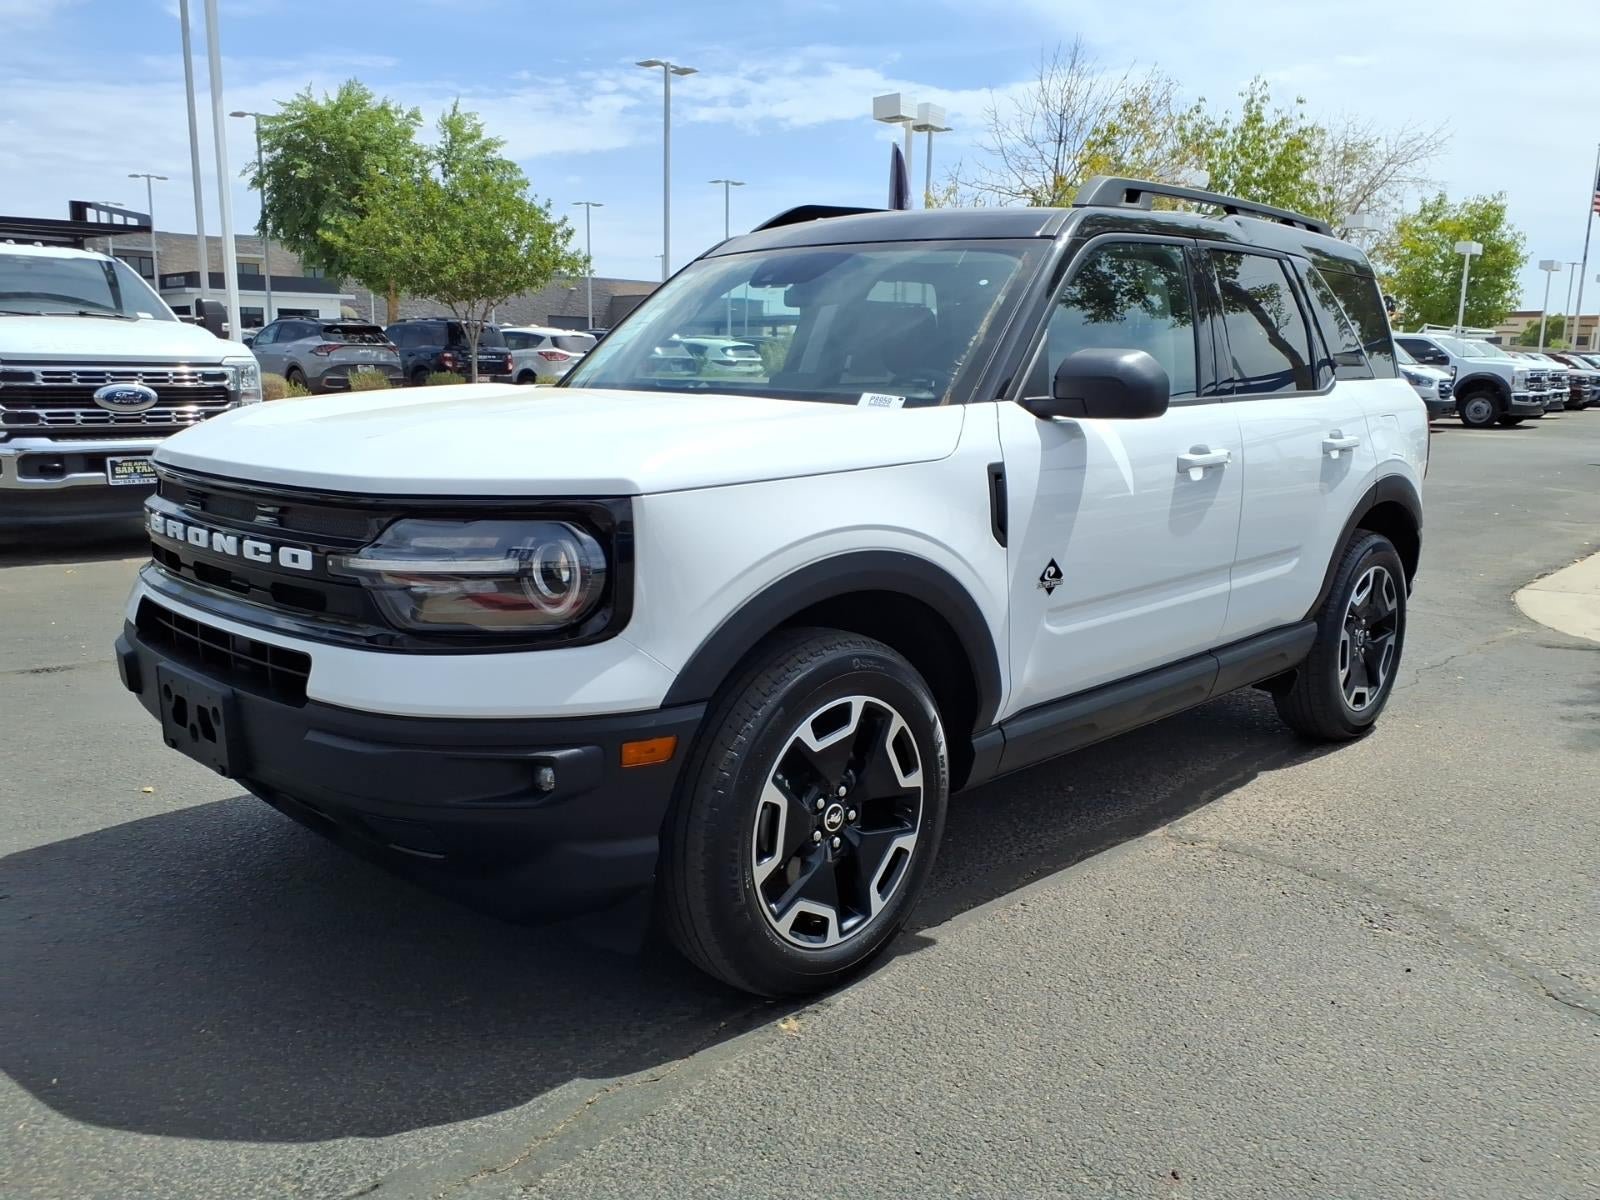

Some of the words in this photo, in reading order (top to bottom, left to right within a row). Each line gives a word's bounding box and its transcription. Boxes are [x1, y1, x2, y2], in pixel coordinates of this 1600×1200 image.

[112, 391, 143, 404] Ford
[115, 466, 134, 474] SAN
[151, 511, 313, 570] BRONCO
